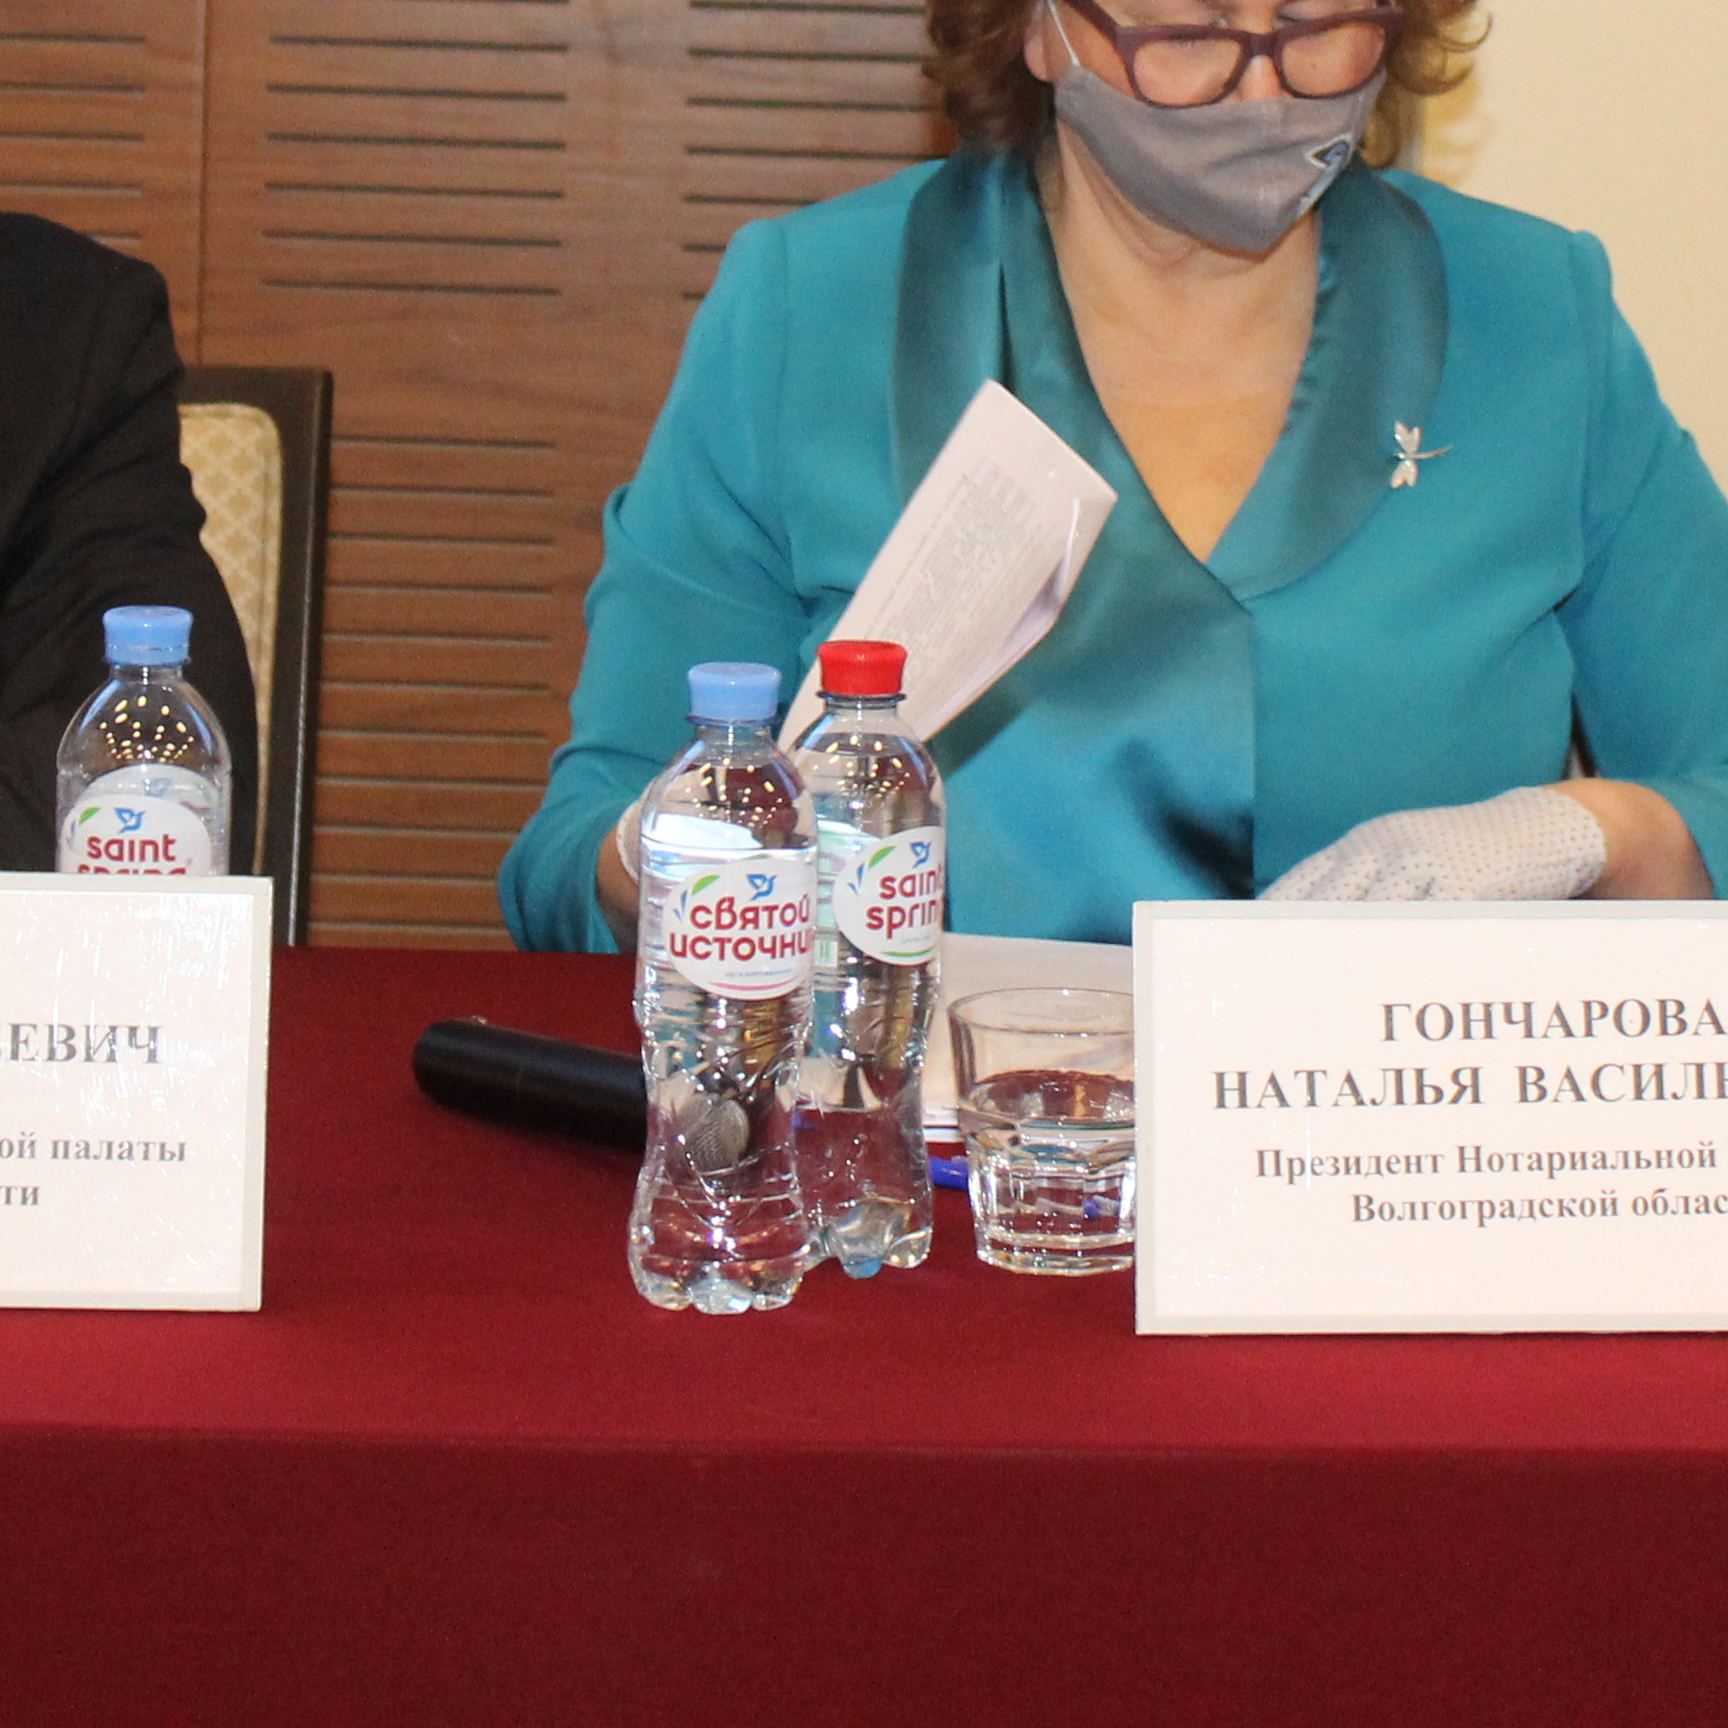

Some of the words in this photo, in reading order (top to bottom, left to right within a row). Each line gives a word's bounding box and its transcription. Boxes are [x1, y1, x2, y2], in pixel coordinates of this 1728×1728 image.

[86, 833, 177, 863] saint
[689, 893, 810, 931] святой
[865, 900, 941, 940] sprin
[669, 927, 812, 962] источни
[1380, 997, 1728, 1043] ГОНЧАРОВА
[1213, 1066, 1485, 1110] НАТАЛЬЯ
[50, 1138, 188, 1164] палаты
[1255, 1147, 1444, 1185] Президент
[1456, 1140, 1718, 1180] Нотариальной
[1352, 1191, 1620, 1229] Волгоградской
